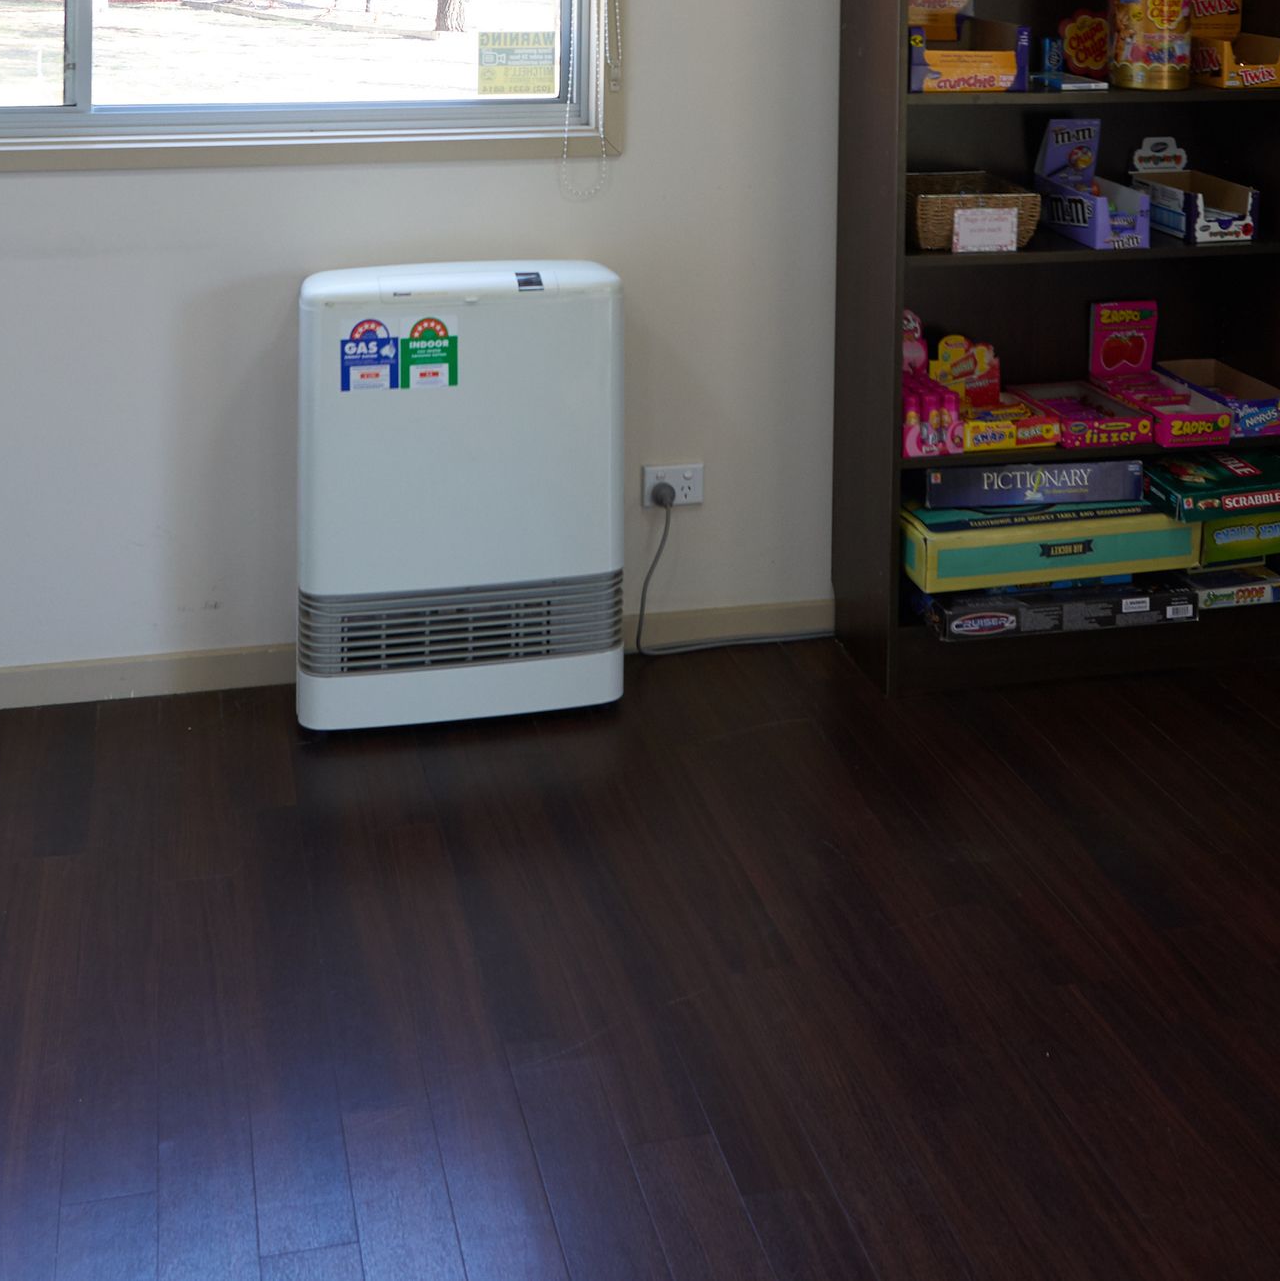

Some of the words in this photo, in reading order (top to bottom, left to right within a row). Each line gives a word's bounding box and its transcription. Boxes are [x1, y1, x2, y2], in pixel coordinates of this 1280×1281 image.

[936, 75, 996, 89] crunchie
[1238, 66, 1276, 86] Twix
[345, 341, 378, 354] GAS
[409, 340, 449, 349] INDOOR
[1085, 429, 1137, 444] fizzer
[983, 469, 1092, 490] PICTIONARY
